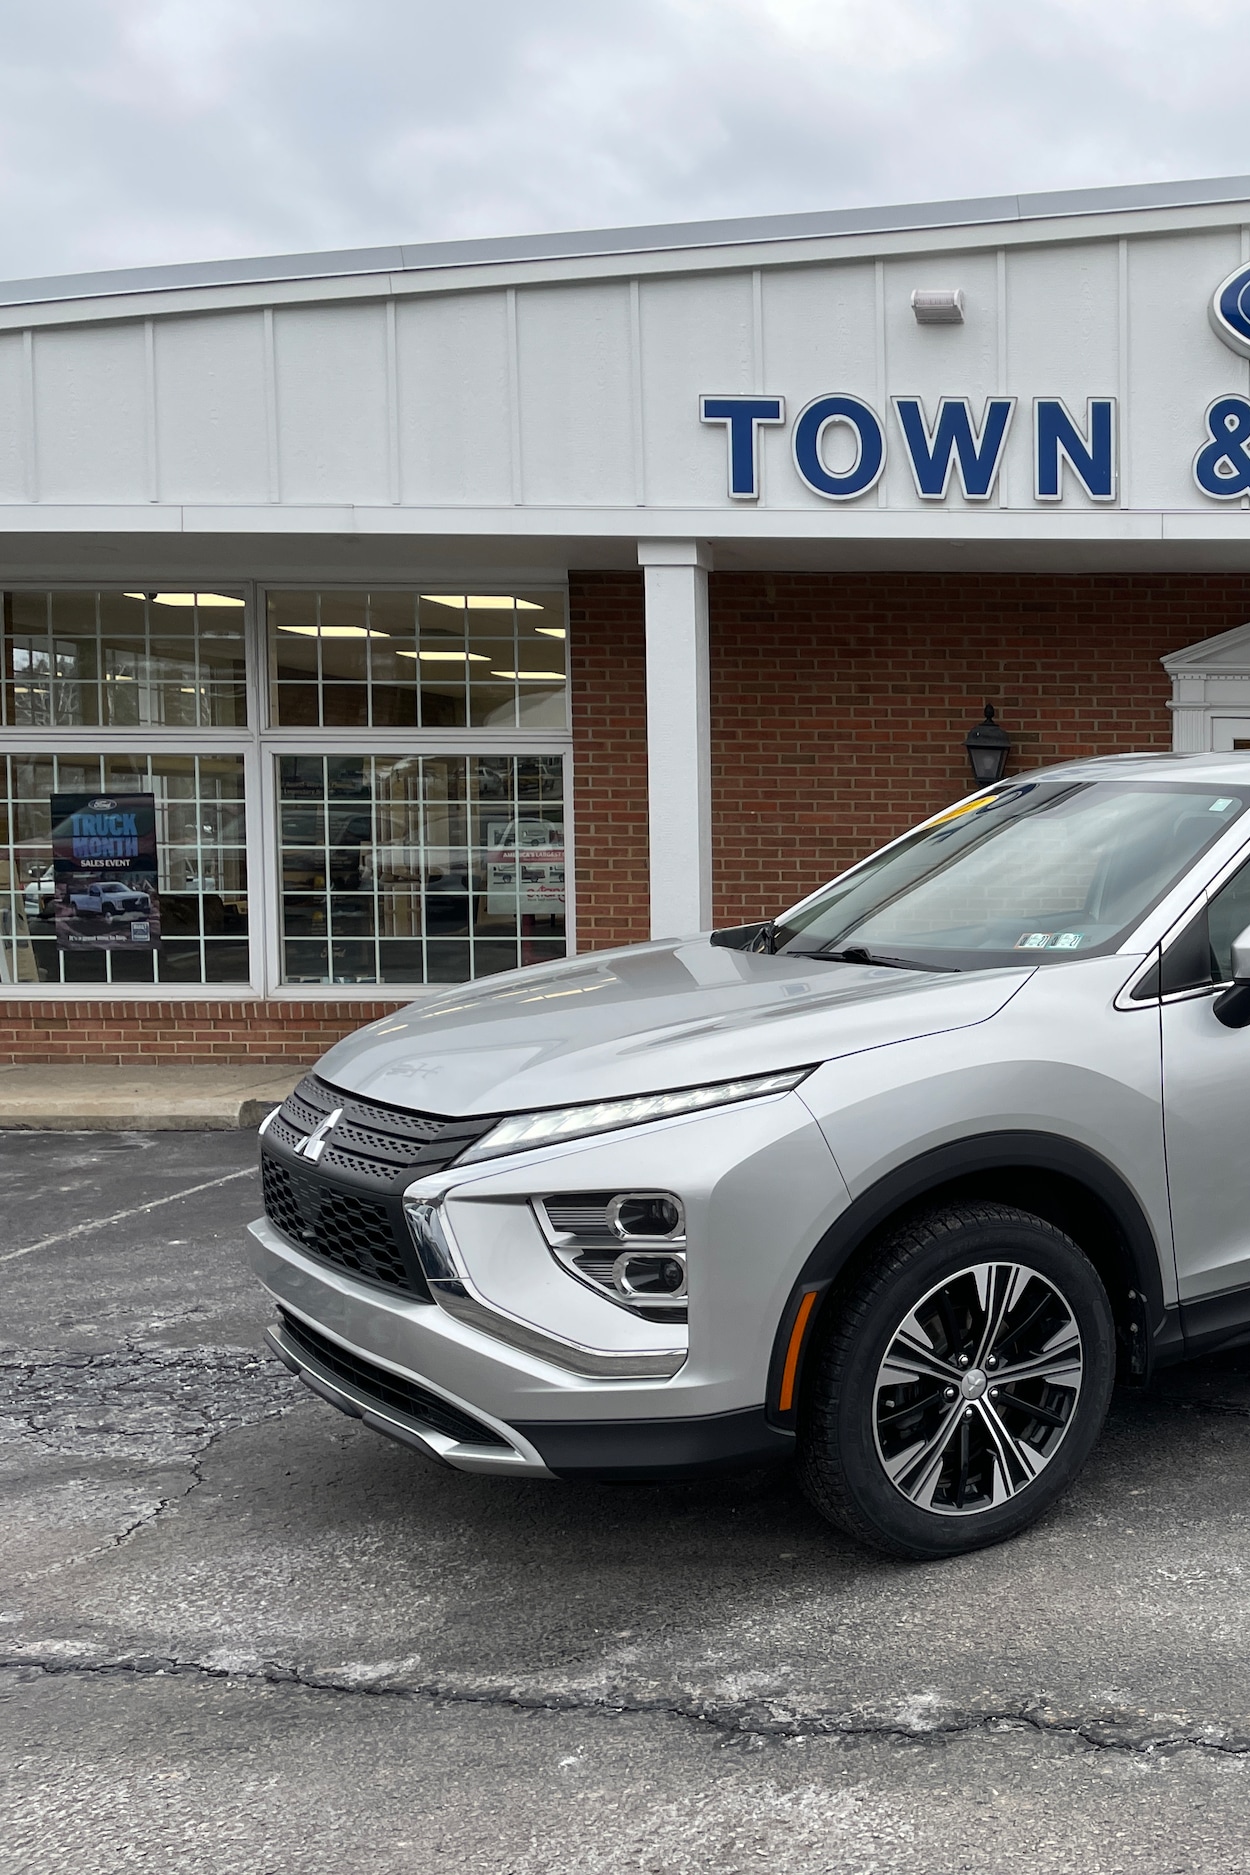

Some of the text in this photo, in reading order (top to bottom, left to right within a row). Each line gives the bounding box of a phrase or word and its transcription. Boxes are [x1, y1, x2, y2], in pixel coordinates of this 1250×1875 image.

[698, 391, 1117, 502] TOWN
[70, 813, 138, 836] TRUCK
[72, 837, 139, 857] MONTH
[81, 859, 131, 867] SALES EVENT
